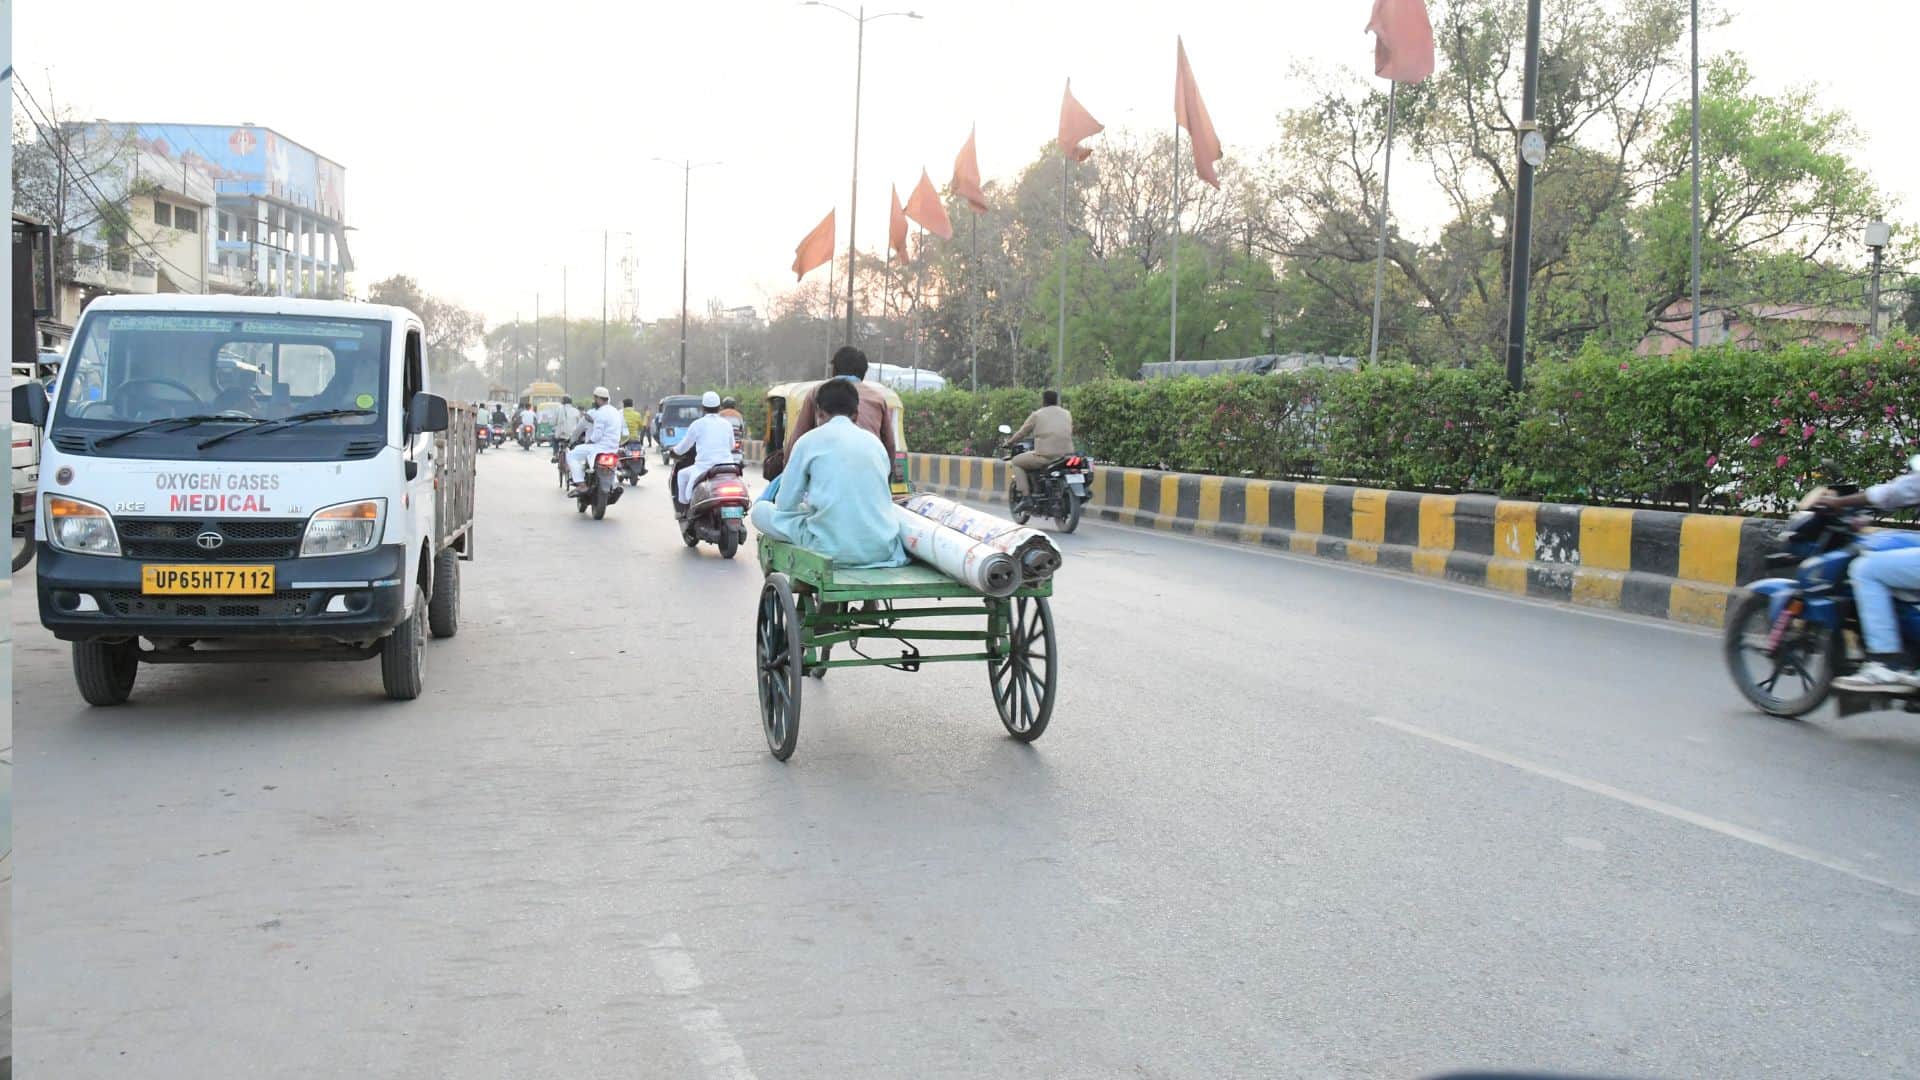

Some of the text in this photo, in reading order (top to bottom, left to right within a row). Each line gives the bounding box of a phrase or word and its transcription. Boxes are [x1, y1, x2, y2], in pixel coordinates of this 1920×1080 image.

[156, 472, 280, 490] OXYGEN GASES
[170, 494, 271, 512] MEDICAL
[156, 571, 270, 589] UP65HT7112
